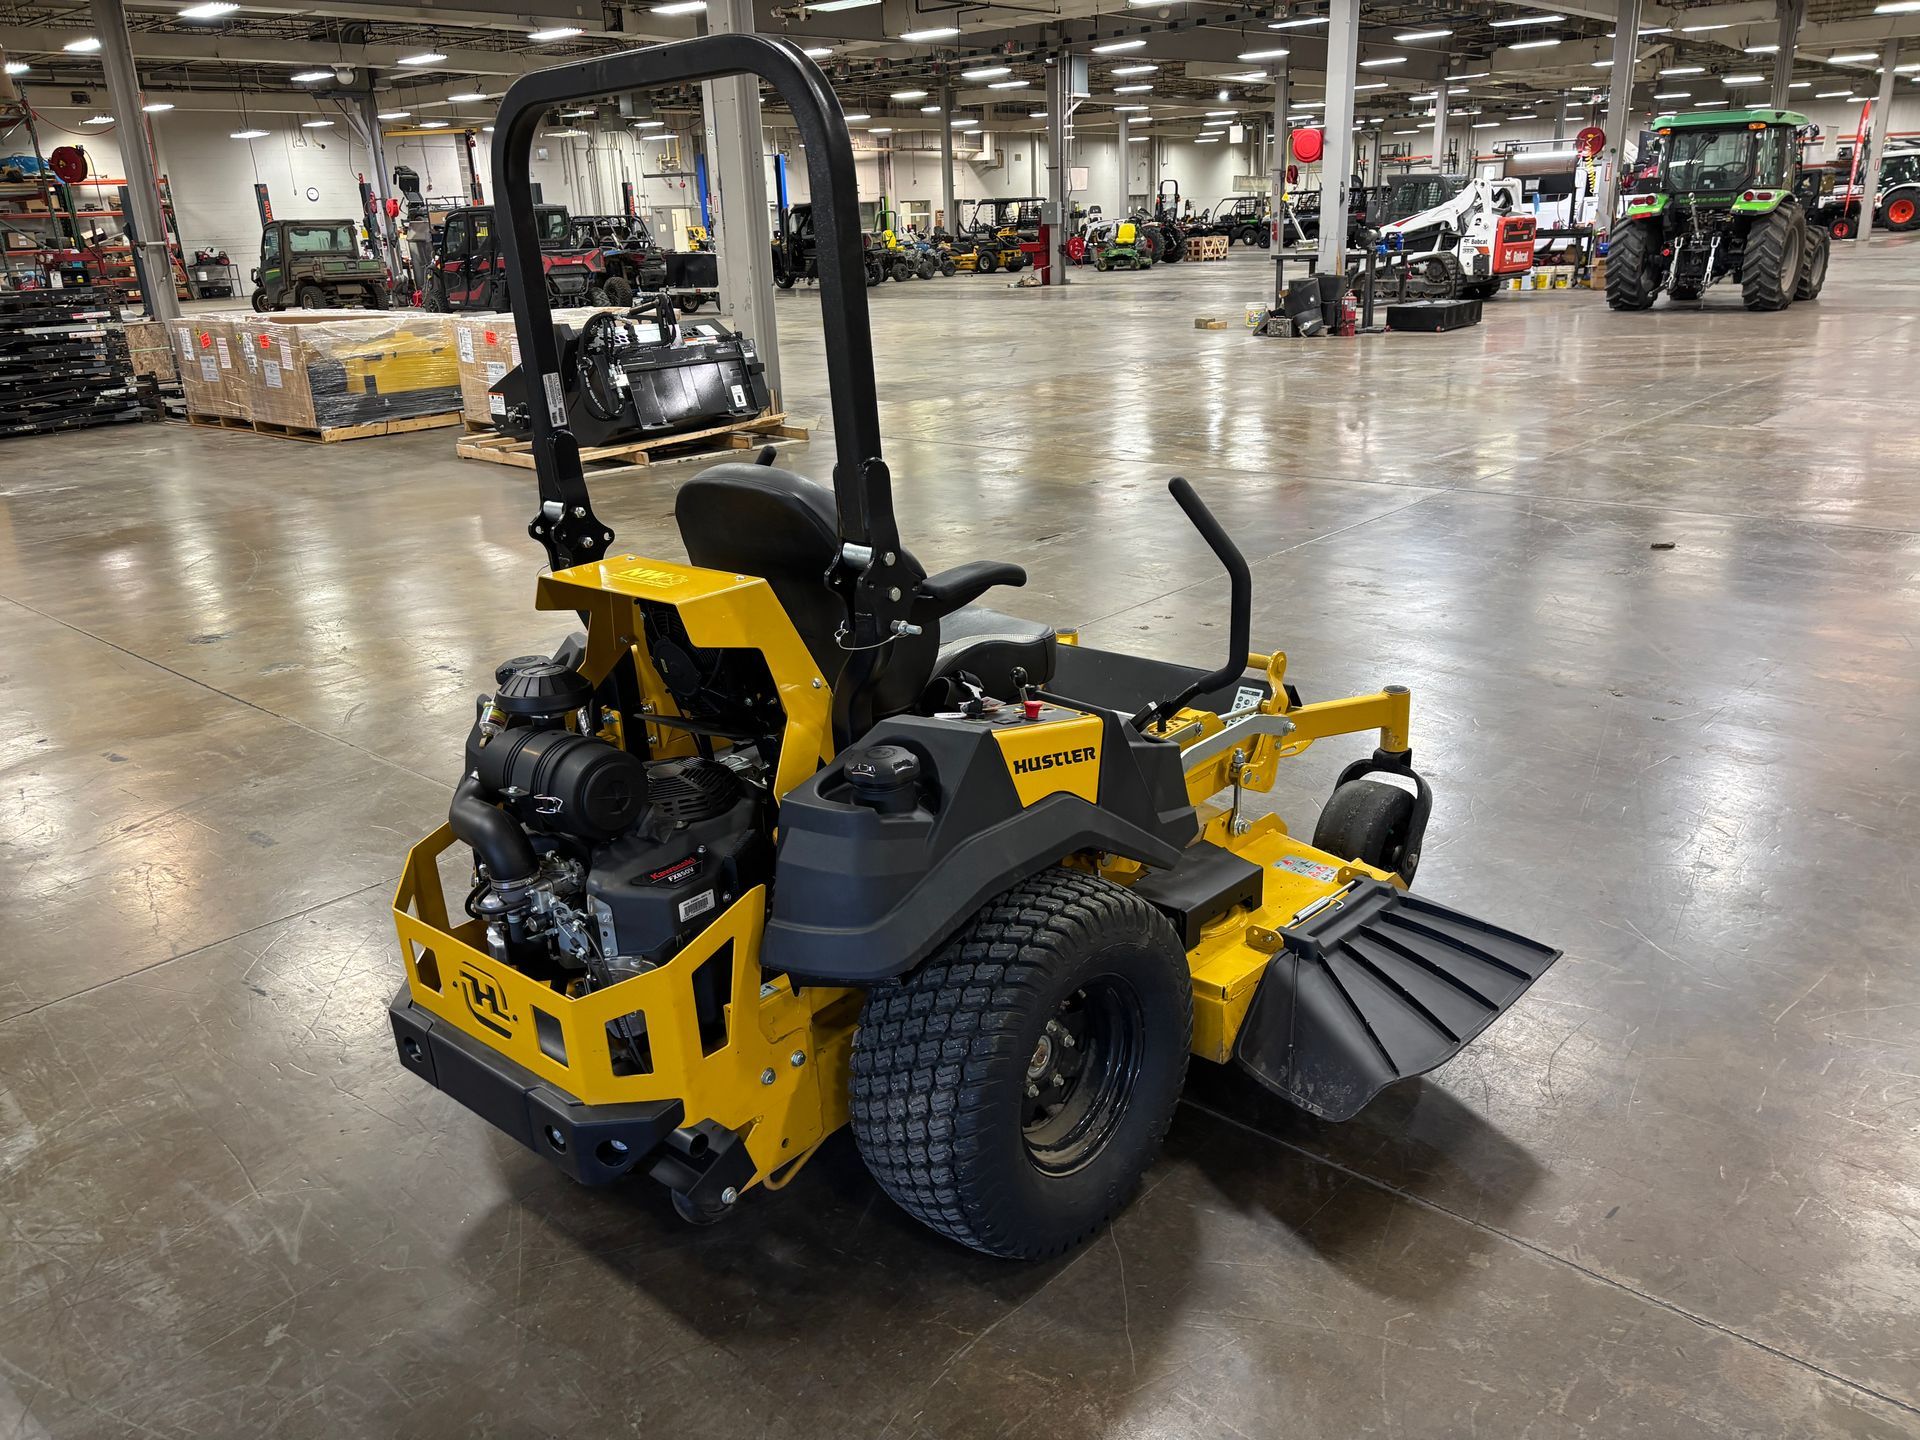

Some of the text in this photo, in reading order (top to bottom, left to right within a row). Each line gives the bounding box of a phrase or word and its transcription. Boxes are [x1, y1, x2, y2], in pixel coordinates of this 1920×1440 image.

[1512, 250, 1529, 263] Bobcat
[1013, 746, 1096, 775] HUSTLER
[650, 857, 697, 880] Kawasaki
[667, 866, 695, 882] FX850V
